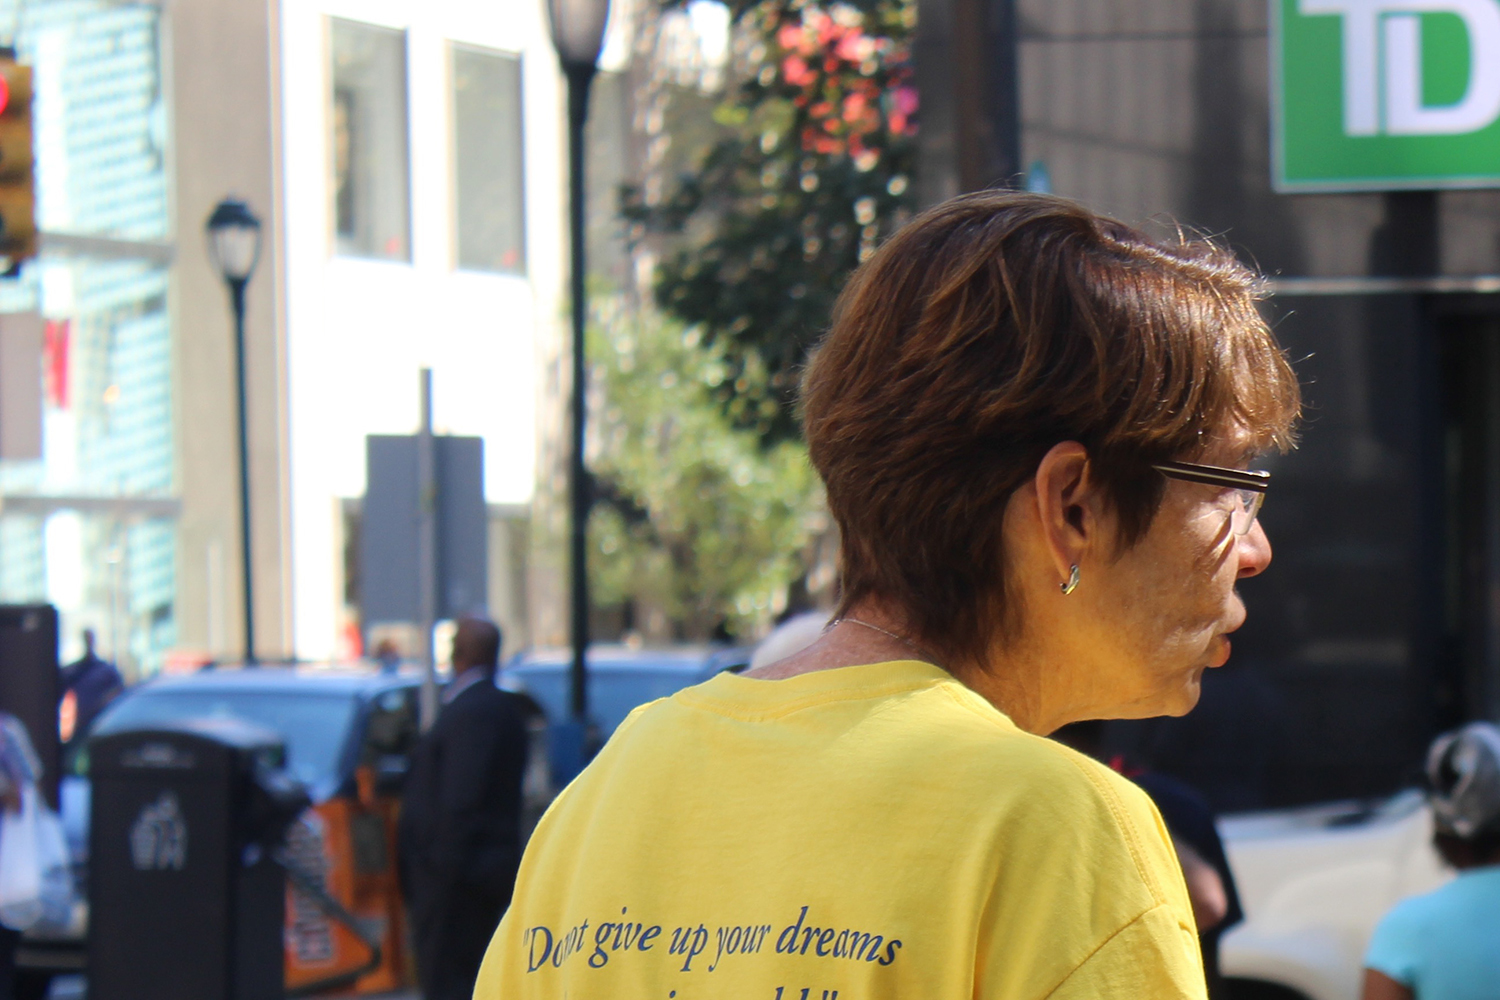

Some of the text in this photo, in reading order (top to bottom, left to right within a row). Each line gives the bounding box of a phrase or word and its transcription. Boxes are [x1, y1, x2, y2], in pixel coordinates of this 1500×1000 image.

[588, 906, 662, 969] give
[668, 923, 709, 973] up
[708, 924, 771, 972] your
[775, 905, 902, 966] dreams
